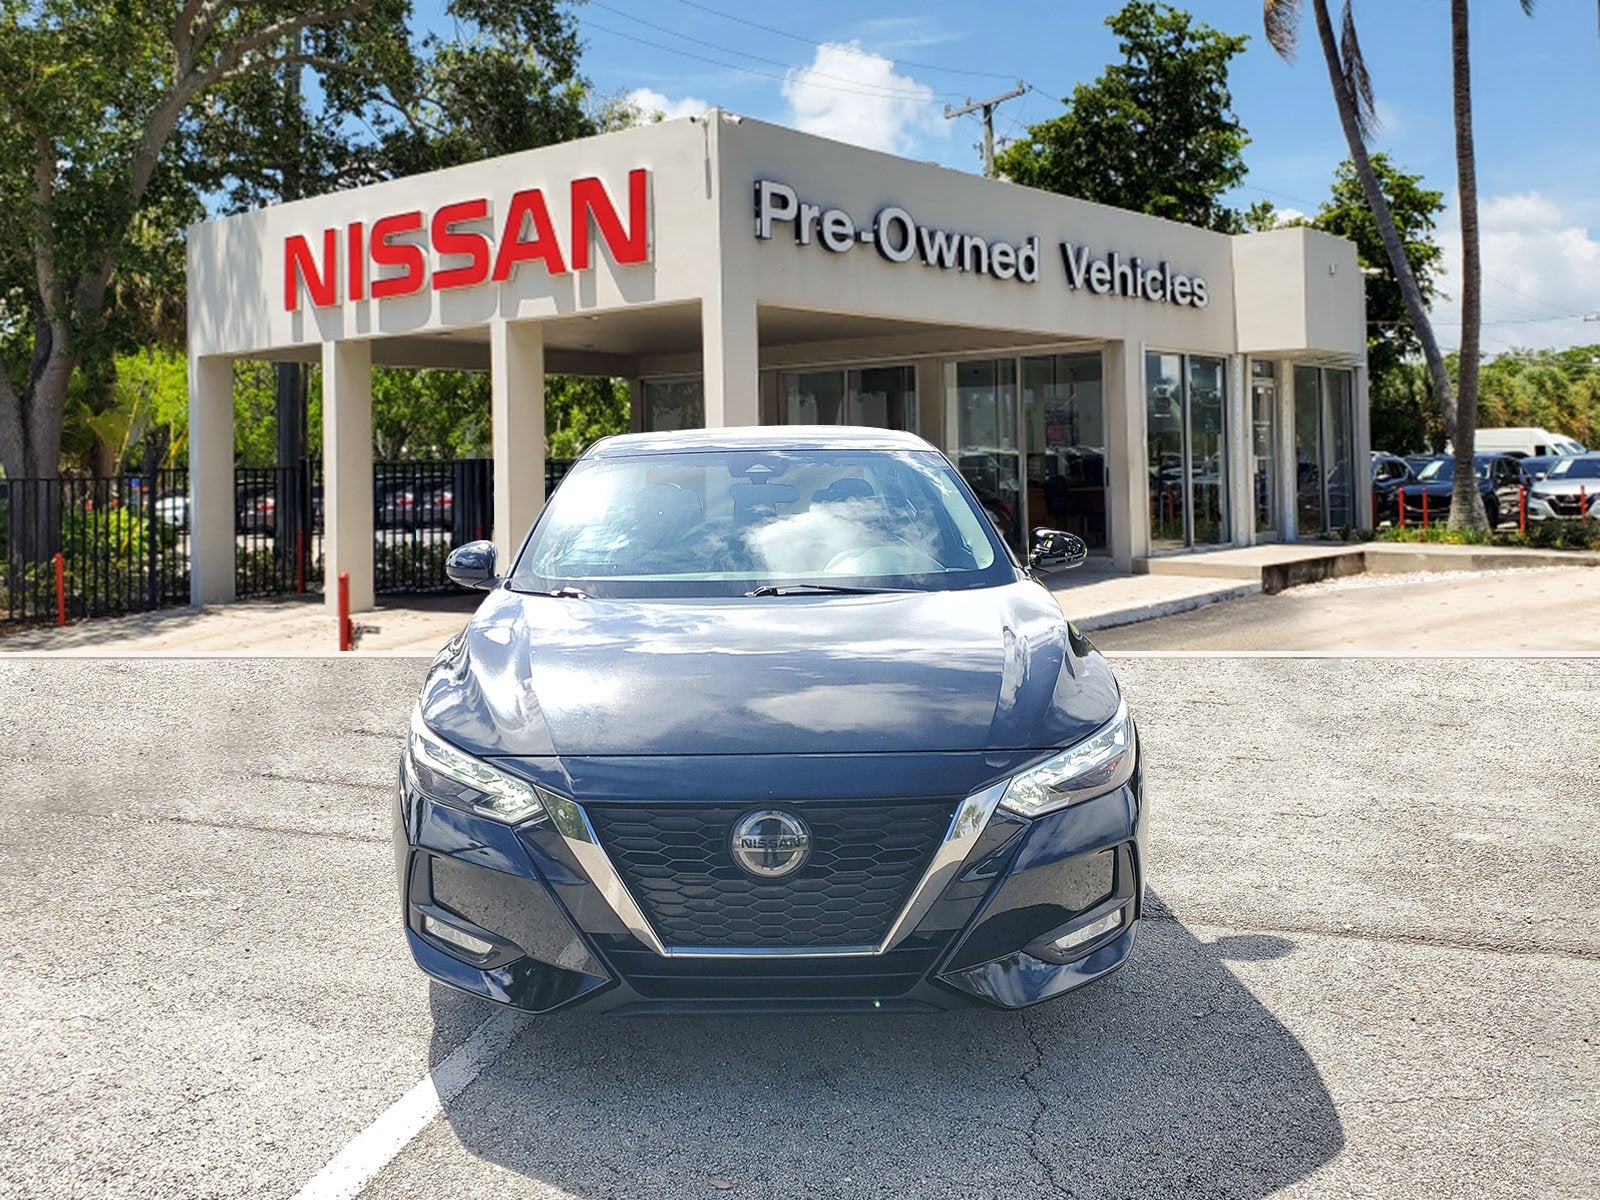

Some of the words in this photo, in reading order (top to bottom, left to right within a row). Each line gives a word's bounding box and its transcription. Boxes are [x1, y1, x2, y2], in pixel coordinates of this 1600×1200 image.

[284, 168, 647, 312] NISSAN
[754, 179, 1040, 283] Pre-Owned
[1060, 242, 1209, 308] Vehicles
[741, 837, 801, 849] NISSAN
